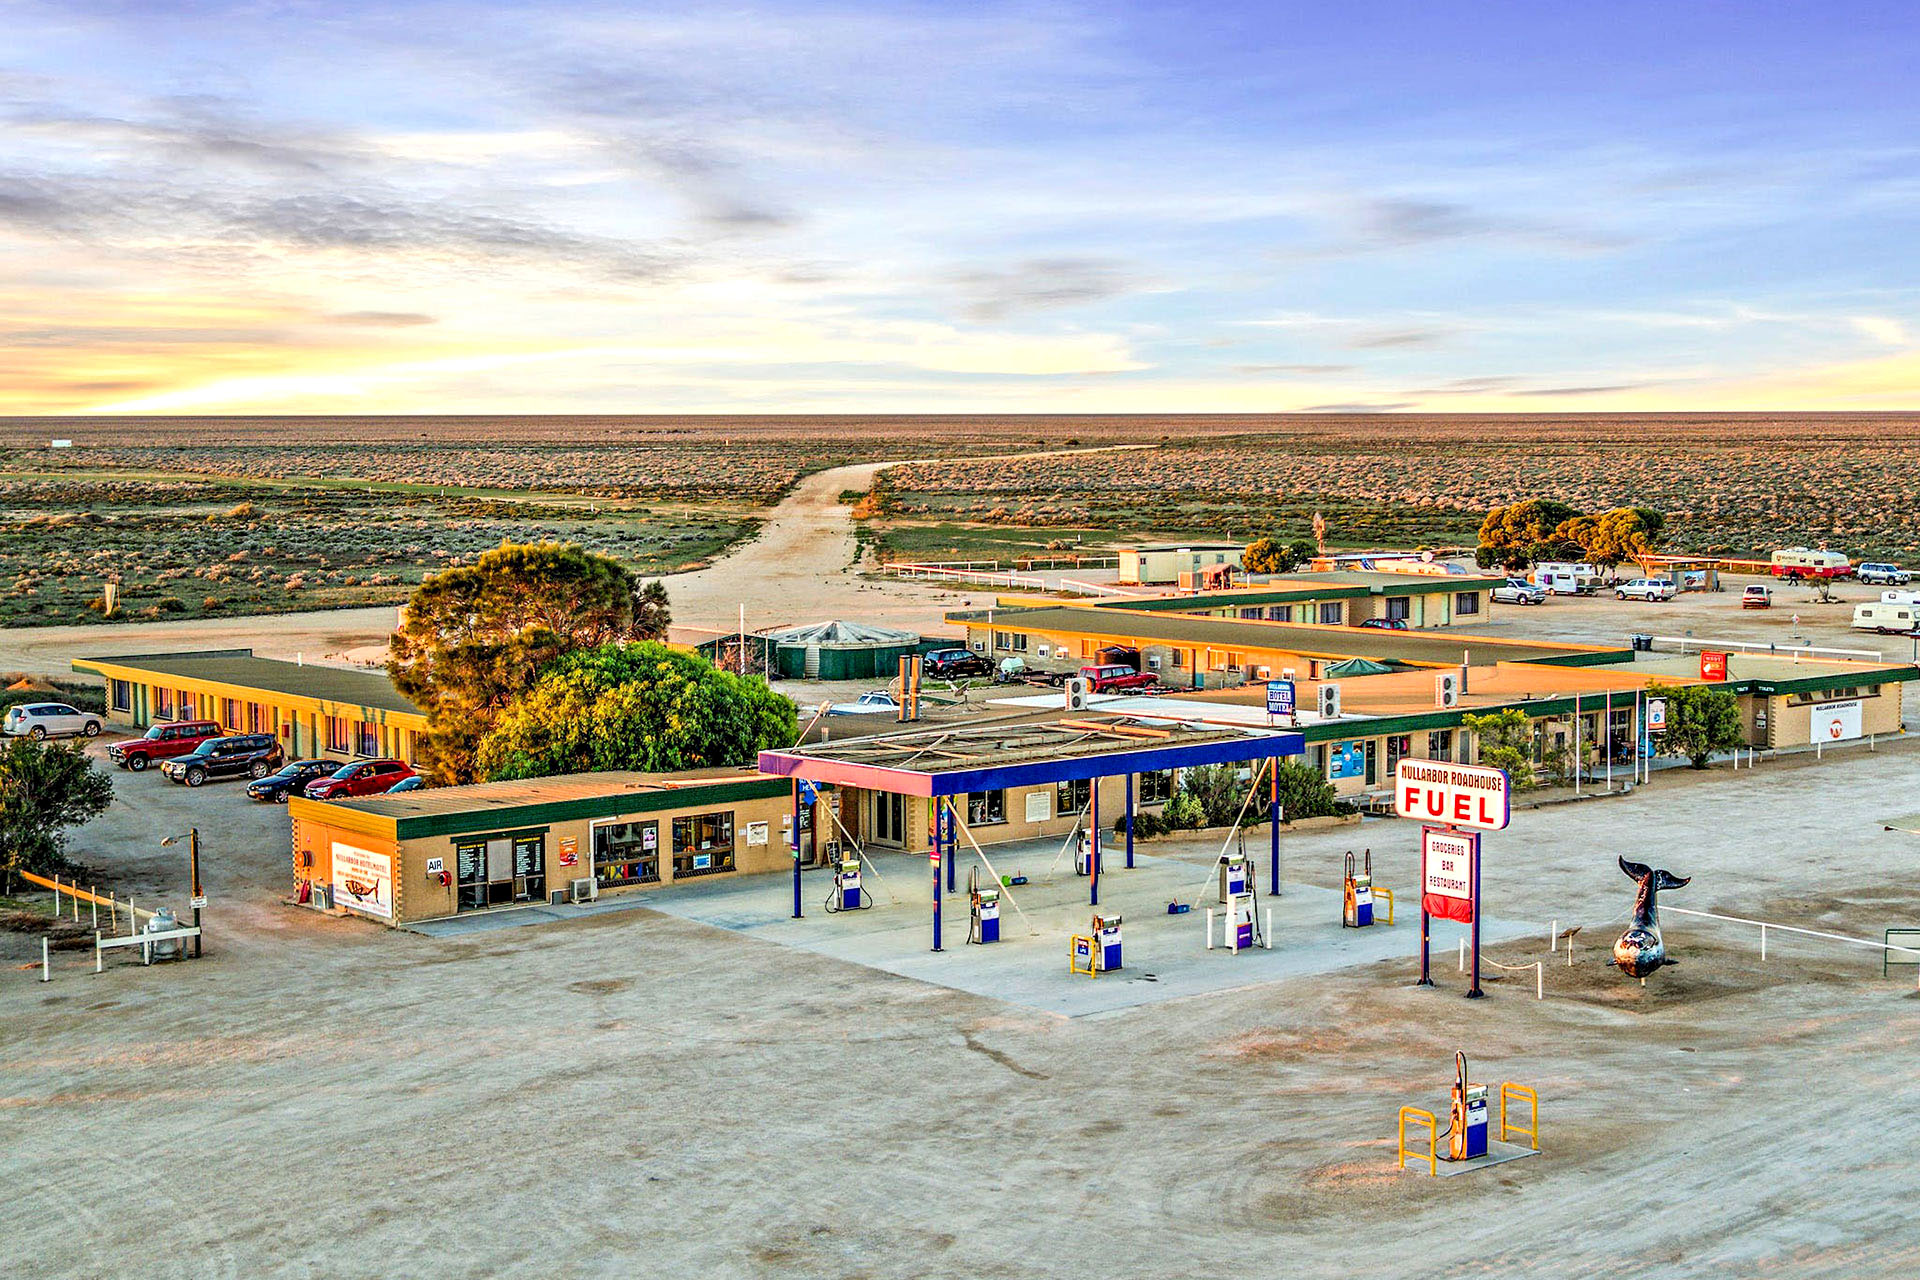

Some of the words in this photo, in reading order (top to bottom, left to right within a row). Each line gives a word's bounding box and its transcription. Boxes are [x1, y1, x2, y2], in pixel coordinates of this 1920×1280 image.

[1269, 691, 1290, 701] HOTEL
[1268, 702, 1291, 712] MOTEL
[1401, 765, 1449, 785] NULLARBOR
[1451, 771, 1502, 792] ROADHOUSE
[1405, 787, 1494, 824] FUEL
[1431, 841, 1465, 857] GROCERIES
[428, 860, 443, 871] AIR
[1442, 860, 1454, 872] BAR
[1429, 875, 1466, 892] RESTAURANT
